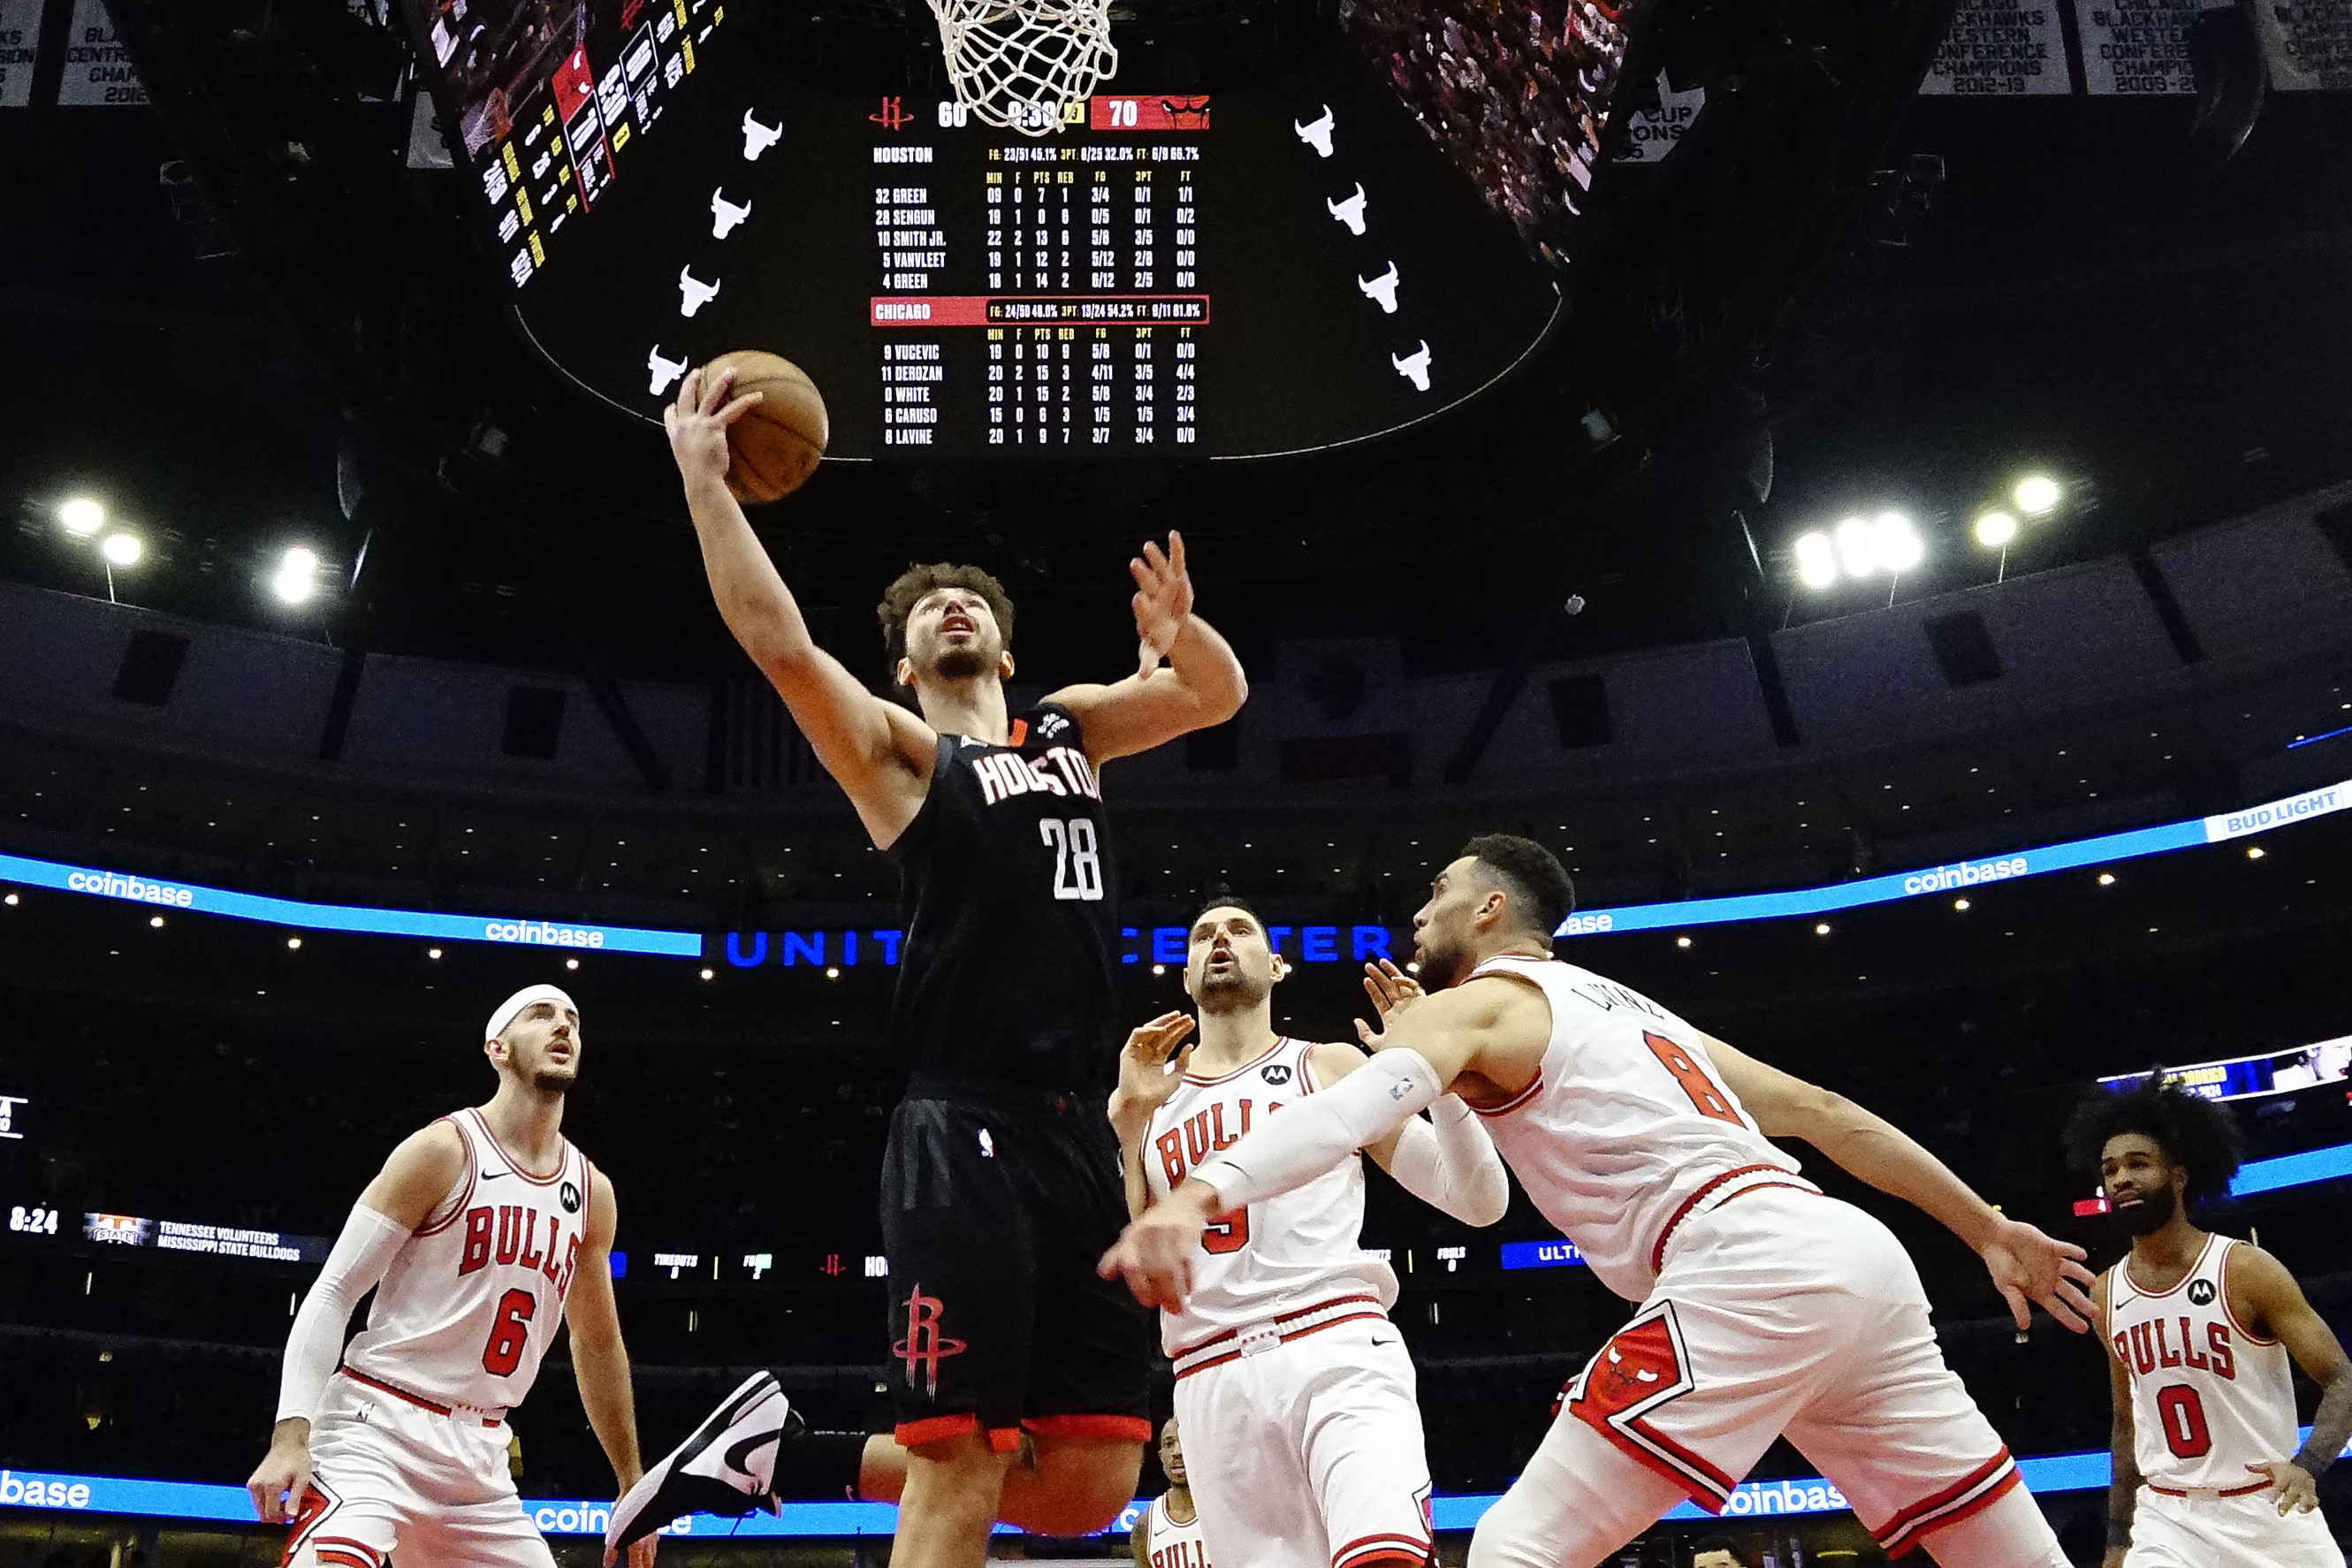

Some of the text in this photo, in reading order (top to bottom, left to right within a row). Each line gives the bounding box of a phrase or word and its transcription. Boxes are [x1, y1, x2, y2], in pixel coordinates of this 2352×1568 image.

[1949, 27, 2031, 43] ESTERN
[1933, 59, 2043, 76] CHAMPIONS
[938, 101, 968, 127] 60
[1109, 100, 1138, 127] 70
[873, 147, 933, 164] HOUSTON
[1003, 148, 1030, 164] 23/51
[986, 171, 1191, 185] MIN F PTS REB FG 3PT FT
[875, 186, 1193, 204] 32 GREEN 09 7 3/4 0/1 1/1
[893, 209, 935, 225] SENGUN
[987, 209, 1001, 225] 19
[1038, 209, 1046, 225] 0
[1091, 209, 1110, 225] 0/5
[1134, 208, 1151, 225] 0/1
[1176, 208, 1195, 225] 0/2
[877, 232, 891, 247] 10
[893, 231, 927, 247] SMITH
[928, 231, 947, 247] JR.
[986, 231, 1002, 247] 22
[1035, 231, 1048, 246] 13
[1134, 229, 1153, 246] 3/5
[1176, 229, 1196, 246] 0/0
[882, 253, 891, 269] 5
[893, 252, 947, 268] VANVLEET
[988, 252, 1001, 268] 19
[1035, 252, 1048, 267] 12
[1092, 250, 1115, 268] 5/12
[1176, 250, 1196, 267] 0/0
[882, 274, 891, 290] 4
[894, 274, 928, 290] GREEN
[1035, 273, 1048, 288] 14
[1134, 271, 1153, 288] 2/5
[1176, 271, 1195, 288] 0/0
[874, 303, 932, 321] CHICAGO
[1004, 304, 1031, 320] 24/50
[1081, 304, 1107, 320] 13/24
[1152, 303, 1171, 319] 9/11
[987, 328, 1191, 341] MIN F PTS REB FG 3PT FT
[884, 345, 892, 361] 9
[894, 345, 940, 361] VUCEVIC
[989, 344, 1002, 360] 19
[1036, 344, 1049, 360] 10
[1135, 343, 1152, 360] 0/1
[1176, 343, 1195, 360] 0/0
[880, 364, 1195, 382] 11 DEROZAN 20 15 4/11 3/5 4/4
[884, 387, 893, 403] 0
[894, 387, 931, 403] WHITE
[988, 386, 1003, 402] 20
[1036, 386, 1049, 402] 15
[1135, 384, 1153, 402] 3/4
[1176, 384, 1195, 401] 2/3
[895, 408, 938, 423] CARUSO
[989, 407, 1003, 423] 15
[1093, 407, 1111, 422] 1/5
[1137, 406, 1153, 422] 1/5
[1176, 406, 1196, 422] 3/4
[895, 429, 933, 445] LAVINE
[988, 429, 1004, 445] 20
[1039, 429, 1047, 444] 9
[1092, 428, 1110, 444] 3/7
[1135, 427, 1154, 444] 3/4
[1176, 427, 1196, 444] 0/0
[972, 746, 1102, 806] HOUSTO
[2227, 792, 2337, 833] BUD LIGHT
[1039, 818, 1104, 901] 28
[1904, 857, 2029, 895] coinbase
[67, 872, 193, 908] coinbase
[485, 919, 605, 948] coinbase
[726, 925, 1393, 967] UNIT ETER
[1641, 1028, 1751, 1131] 8
[1156, 1099, 1285, 1191] BULL
[10, 1206, 58, 1235] 8:24
[159, 1221, 279, 1245] TENNESSEE VOLUNTEERS
[157, 1235, 301, 1261] MISSISSIPPI STATE BULLDOGS
[458, 1205, 579, 1304] BULLS
[1437, 1246, 1466, 1260] FOULS
[654, 1253, 698, 1267] TIMEOUTS
[1447, 1260, 1457, 1273] 0
[482, 1288, 537, 1378] 6
[2113, 1315, 2236, 1387] BULLS
[2157, 1383, 2211, 1459] 0
[1720, 1480, 1848, 1518] oinbas
